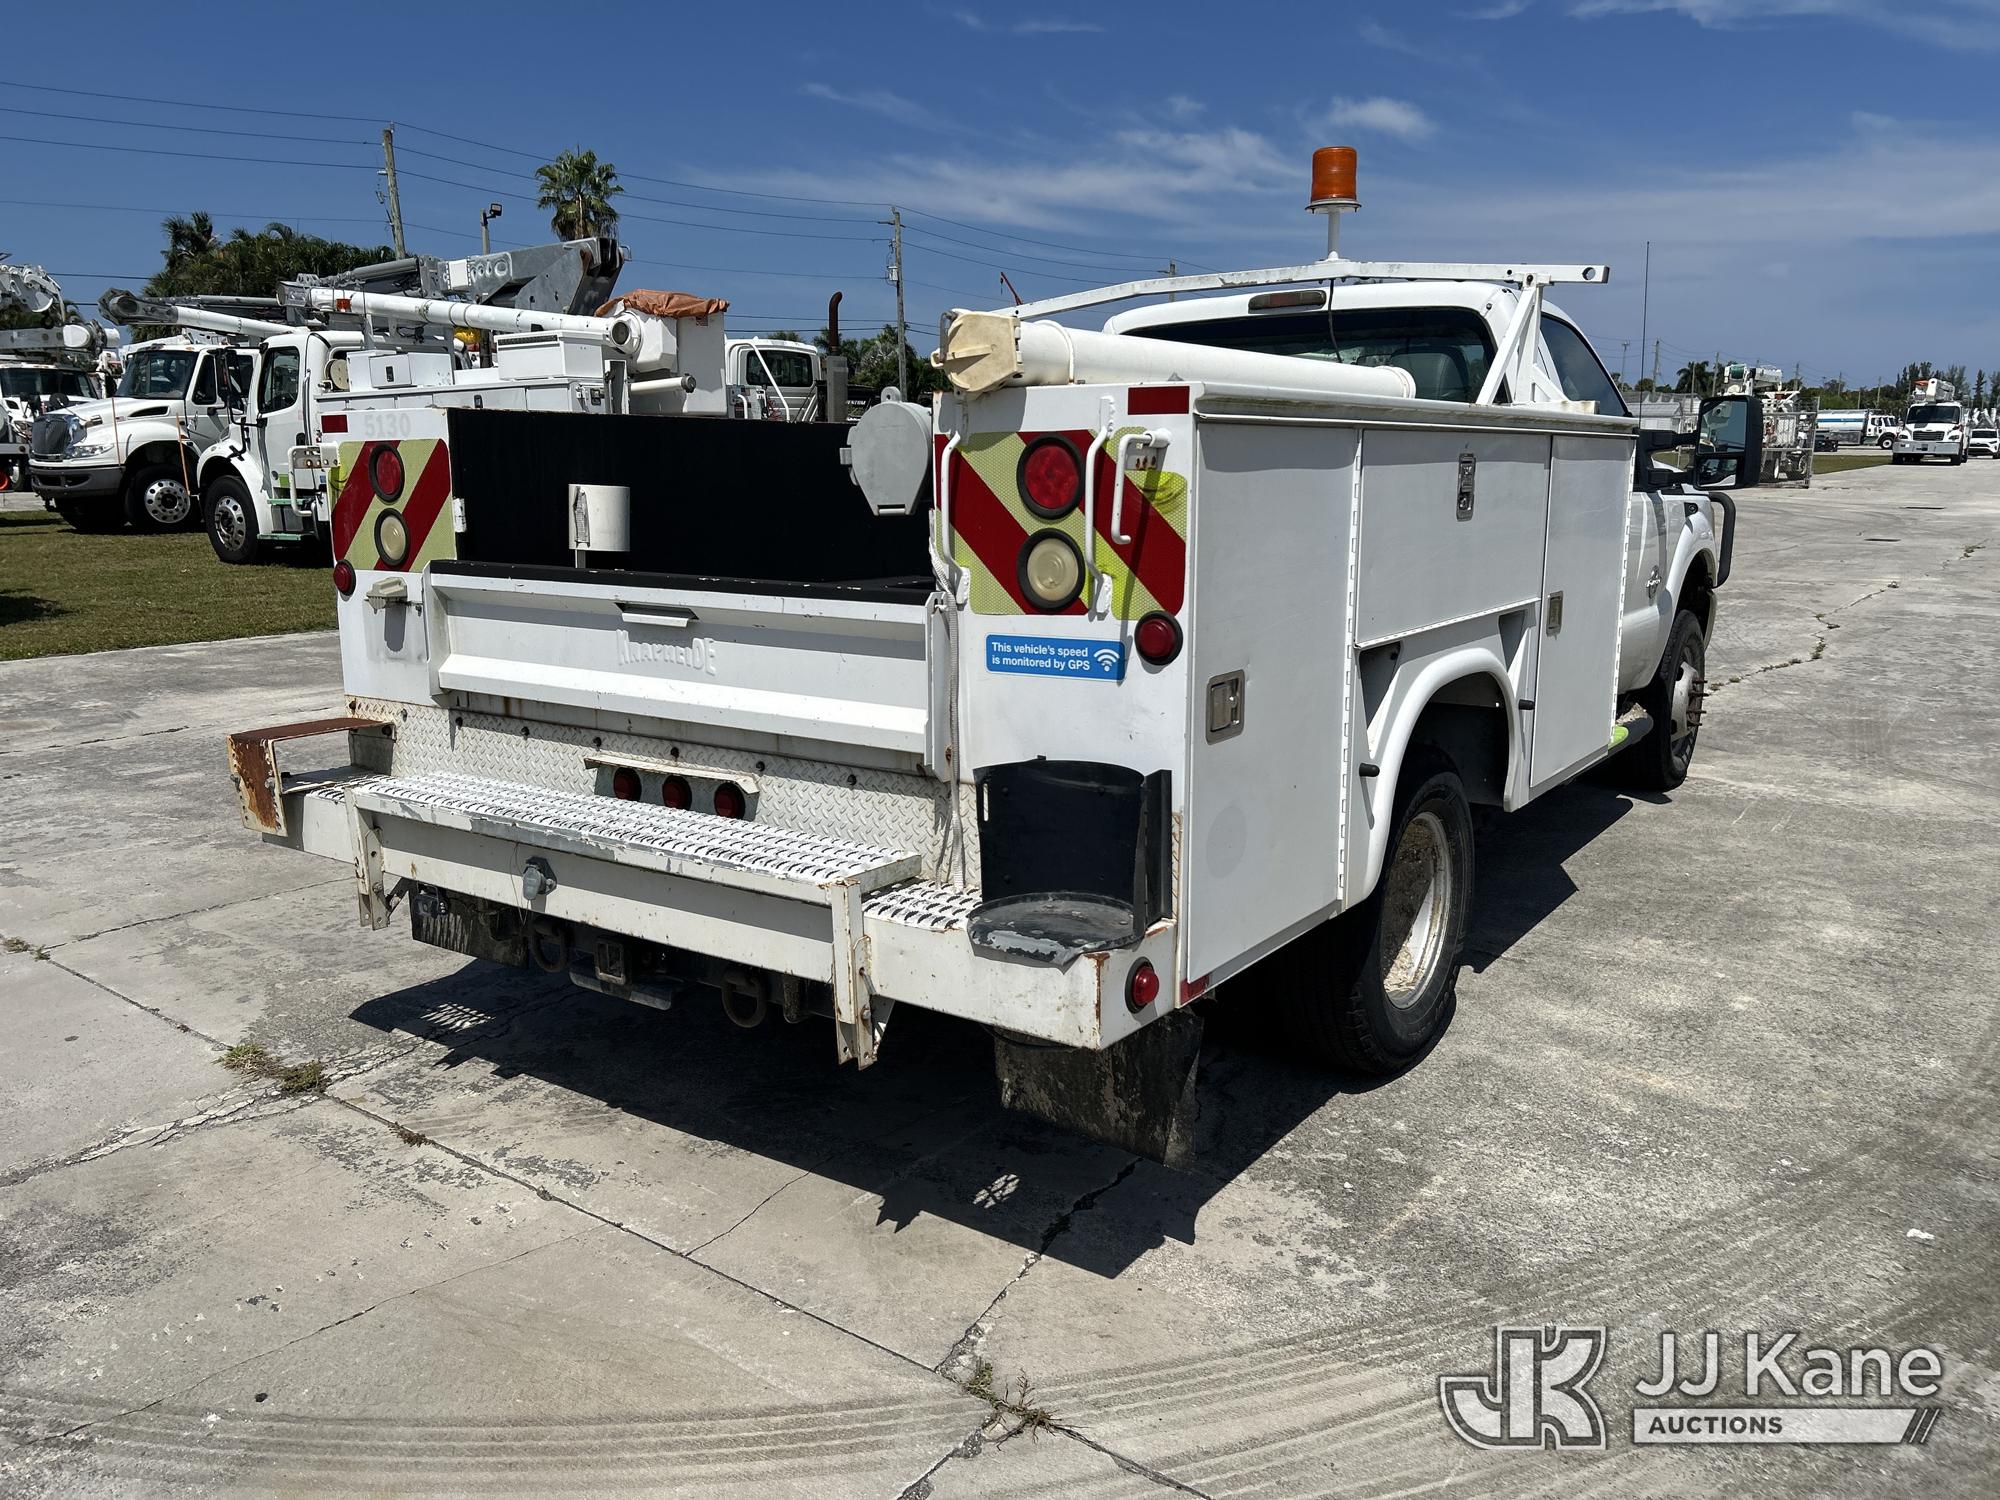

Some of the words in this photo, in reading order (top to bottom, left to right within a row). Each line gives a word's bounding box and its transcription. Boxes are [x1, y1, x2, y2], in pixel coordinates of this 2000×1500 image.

[364, 412, 411, 438] 5130
[991, 641, 1012, 653] This
[1013, 643, 1056, 656] vehicle's
[1057, 646, 1089, 658] speed
[991, 654, 1001, 665] is
[1002, 655, 1051, 669] monitored
[1053, 658, 1066, 671] by
[1067, 659, 1091, 671] GPS
